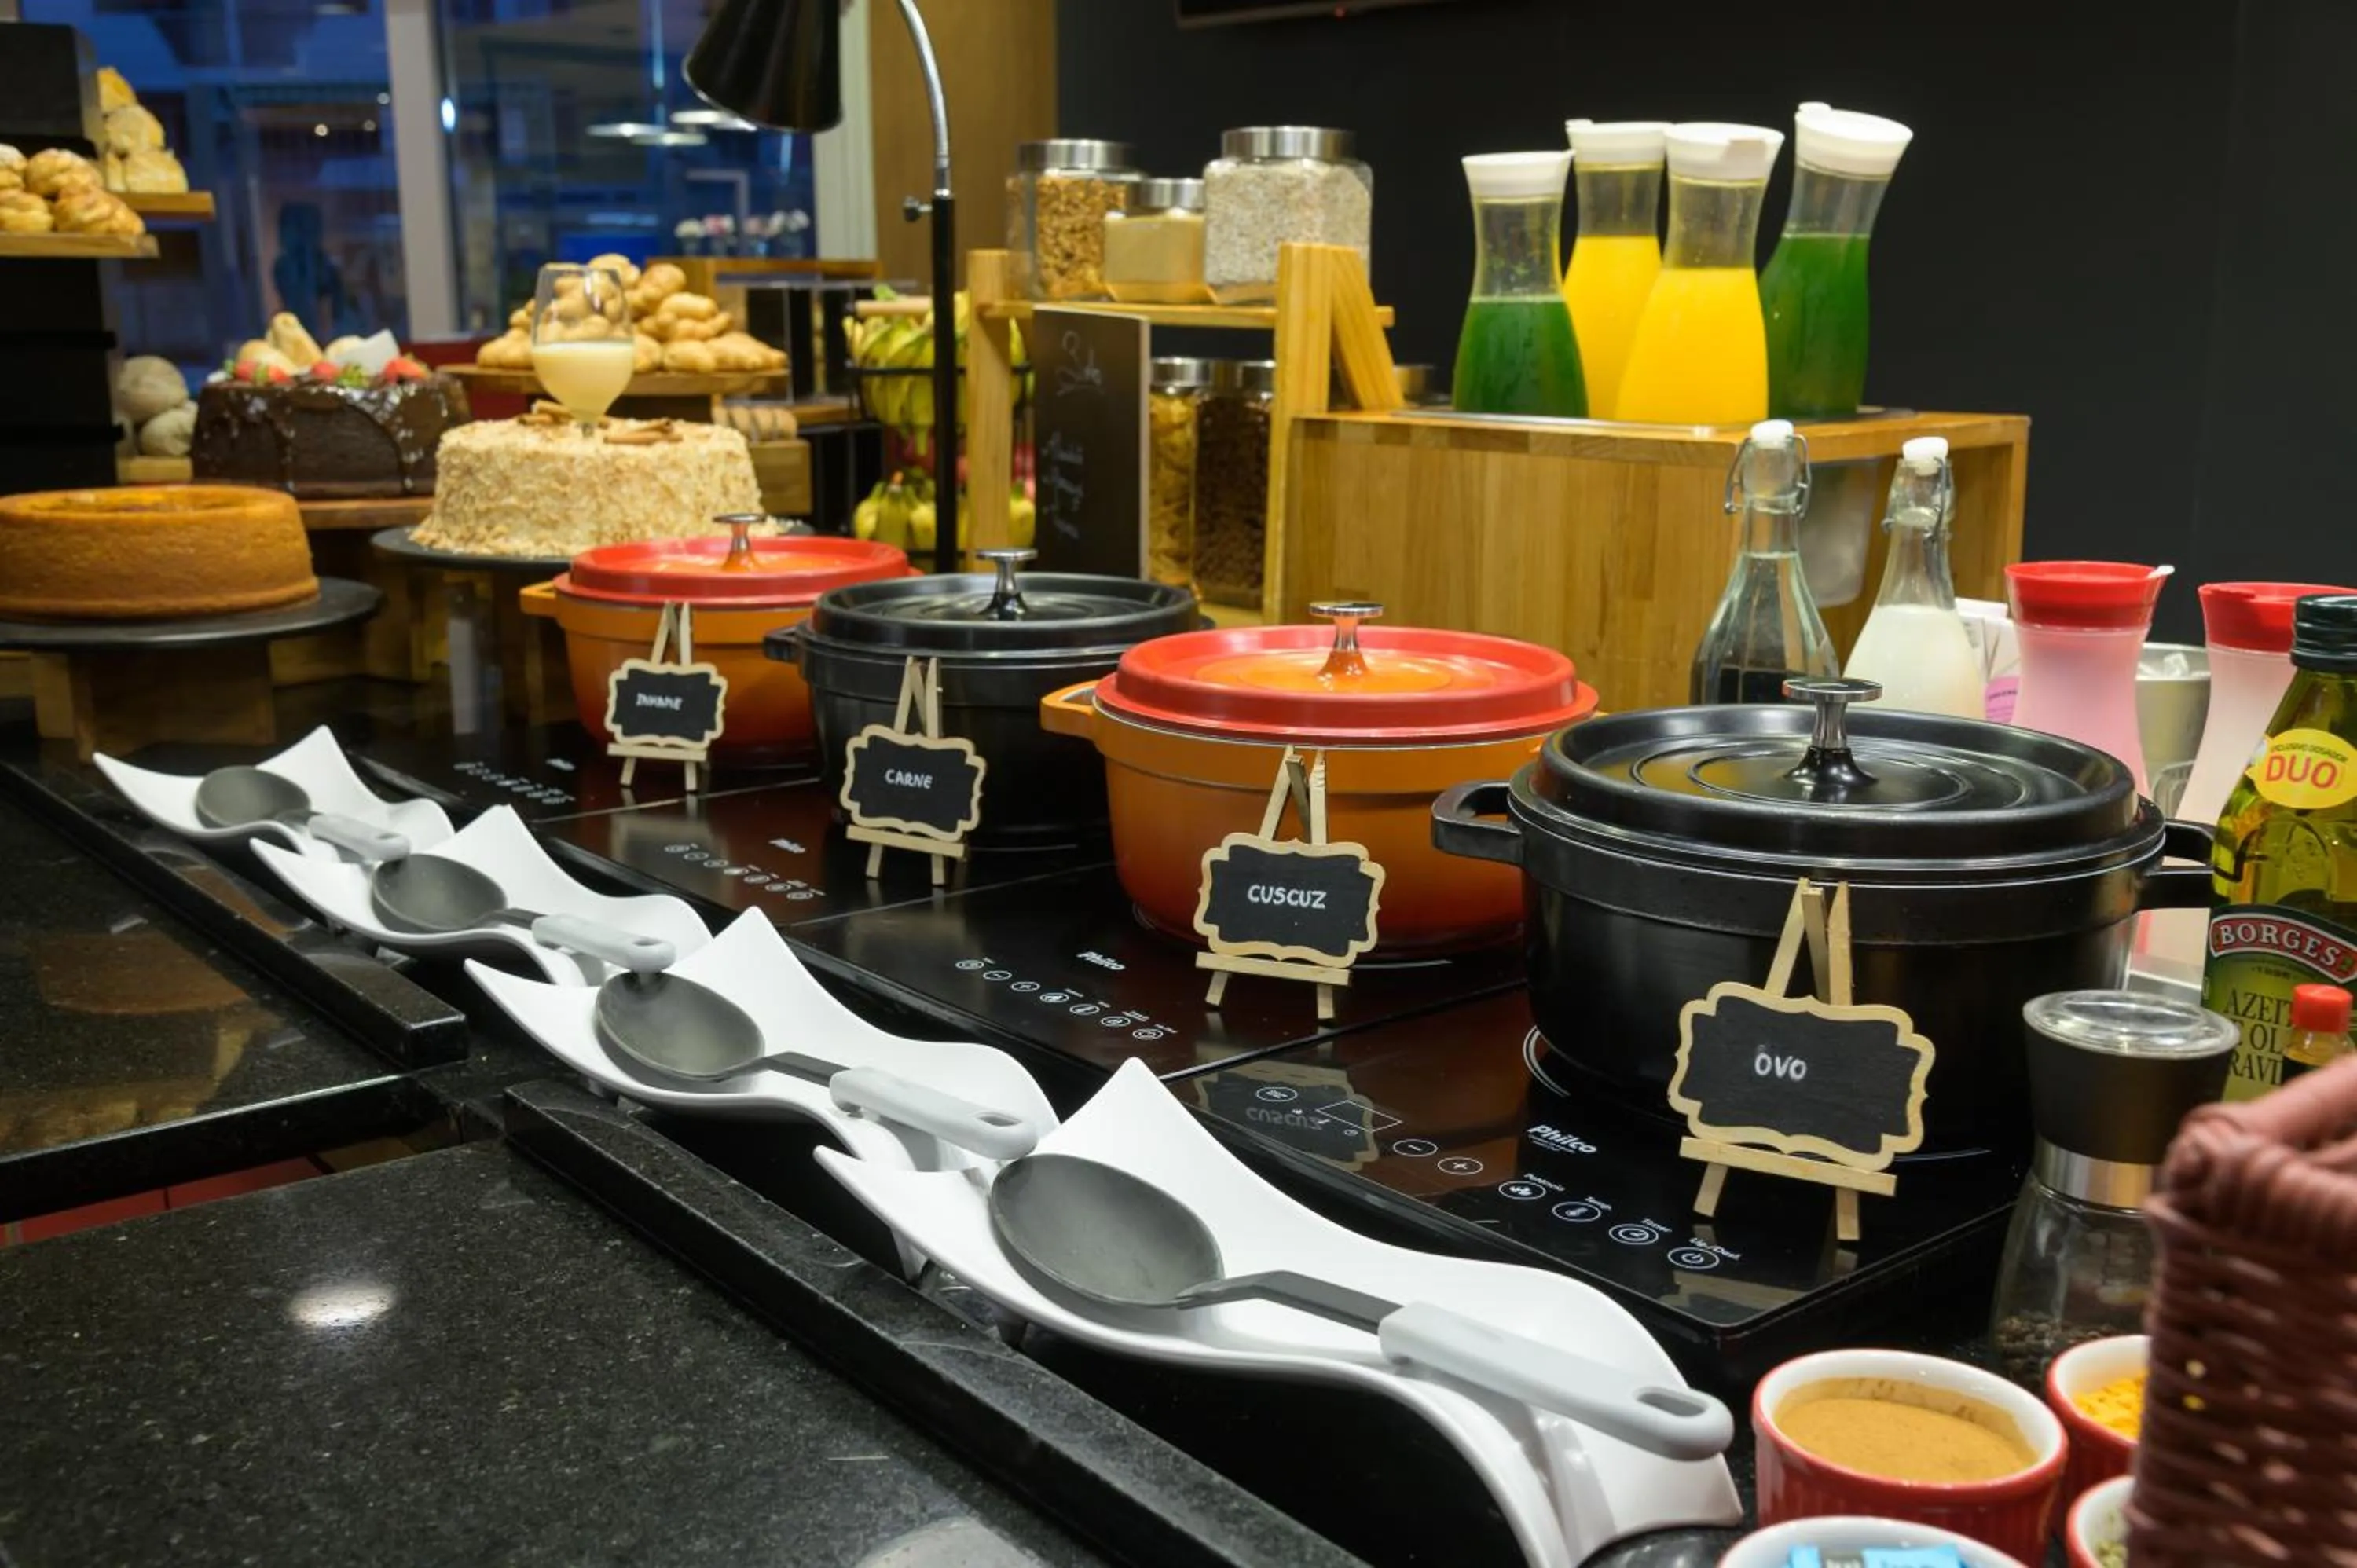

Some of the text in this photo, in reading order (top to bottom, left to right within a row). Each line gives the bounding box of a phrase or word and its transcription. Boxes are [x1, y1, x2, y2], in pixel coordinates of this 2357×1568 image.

[885, 768, 933, 789] CARNE
[2266, 754, 2338, 789] DUO
[1247, 884, 1327, 909] CUSCUZ
[2220, 923, 2341, 966] BORGES
[2223, 988, 2293, 1027] AZEIT
[1527, 1124, 1597, 1153] Philco
